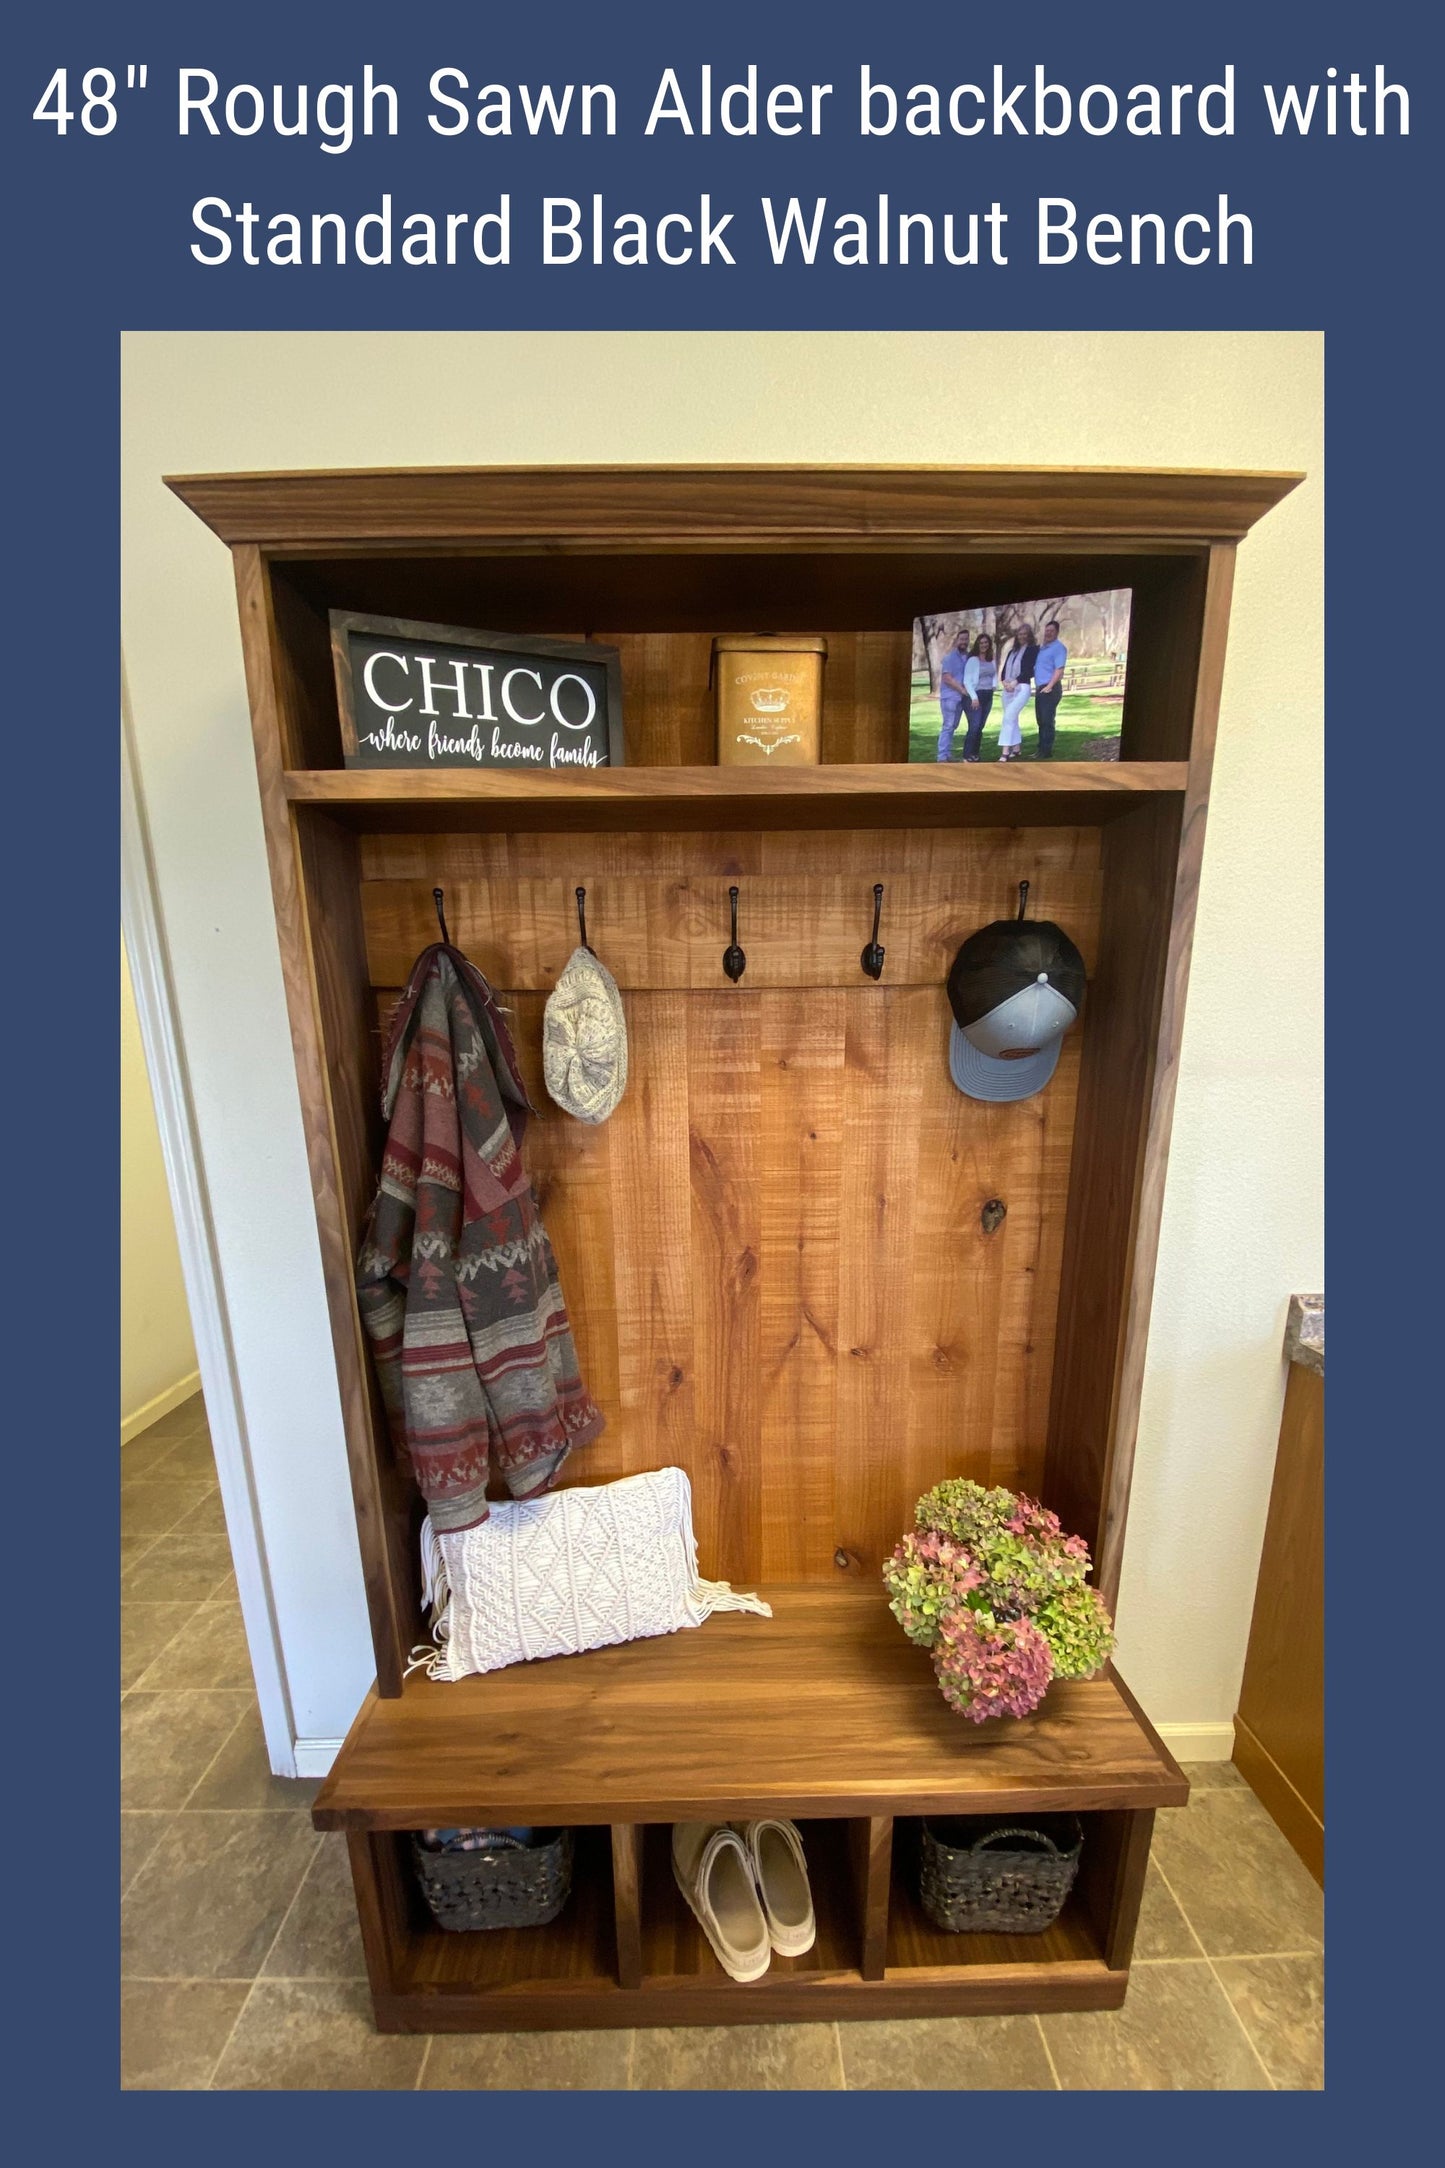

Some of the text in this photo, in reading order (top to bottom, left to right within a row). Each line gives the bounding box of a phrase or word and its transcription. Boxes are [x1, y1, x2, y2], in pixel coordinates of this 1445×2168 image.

[363, 651, 597, 730] CHICO
[359, 716, 608, 769] where friends become family
